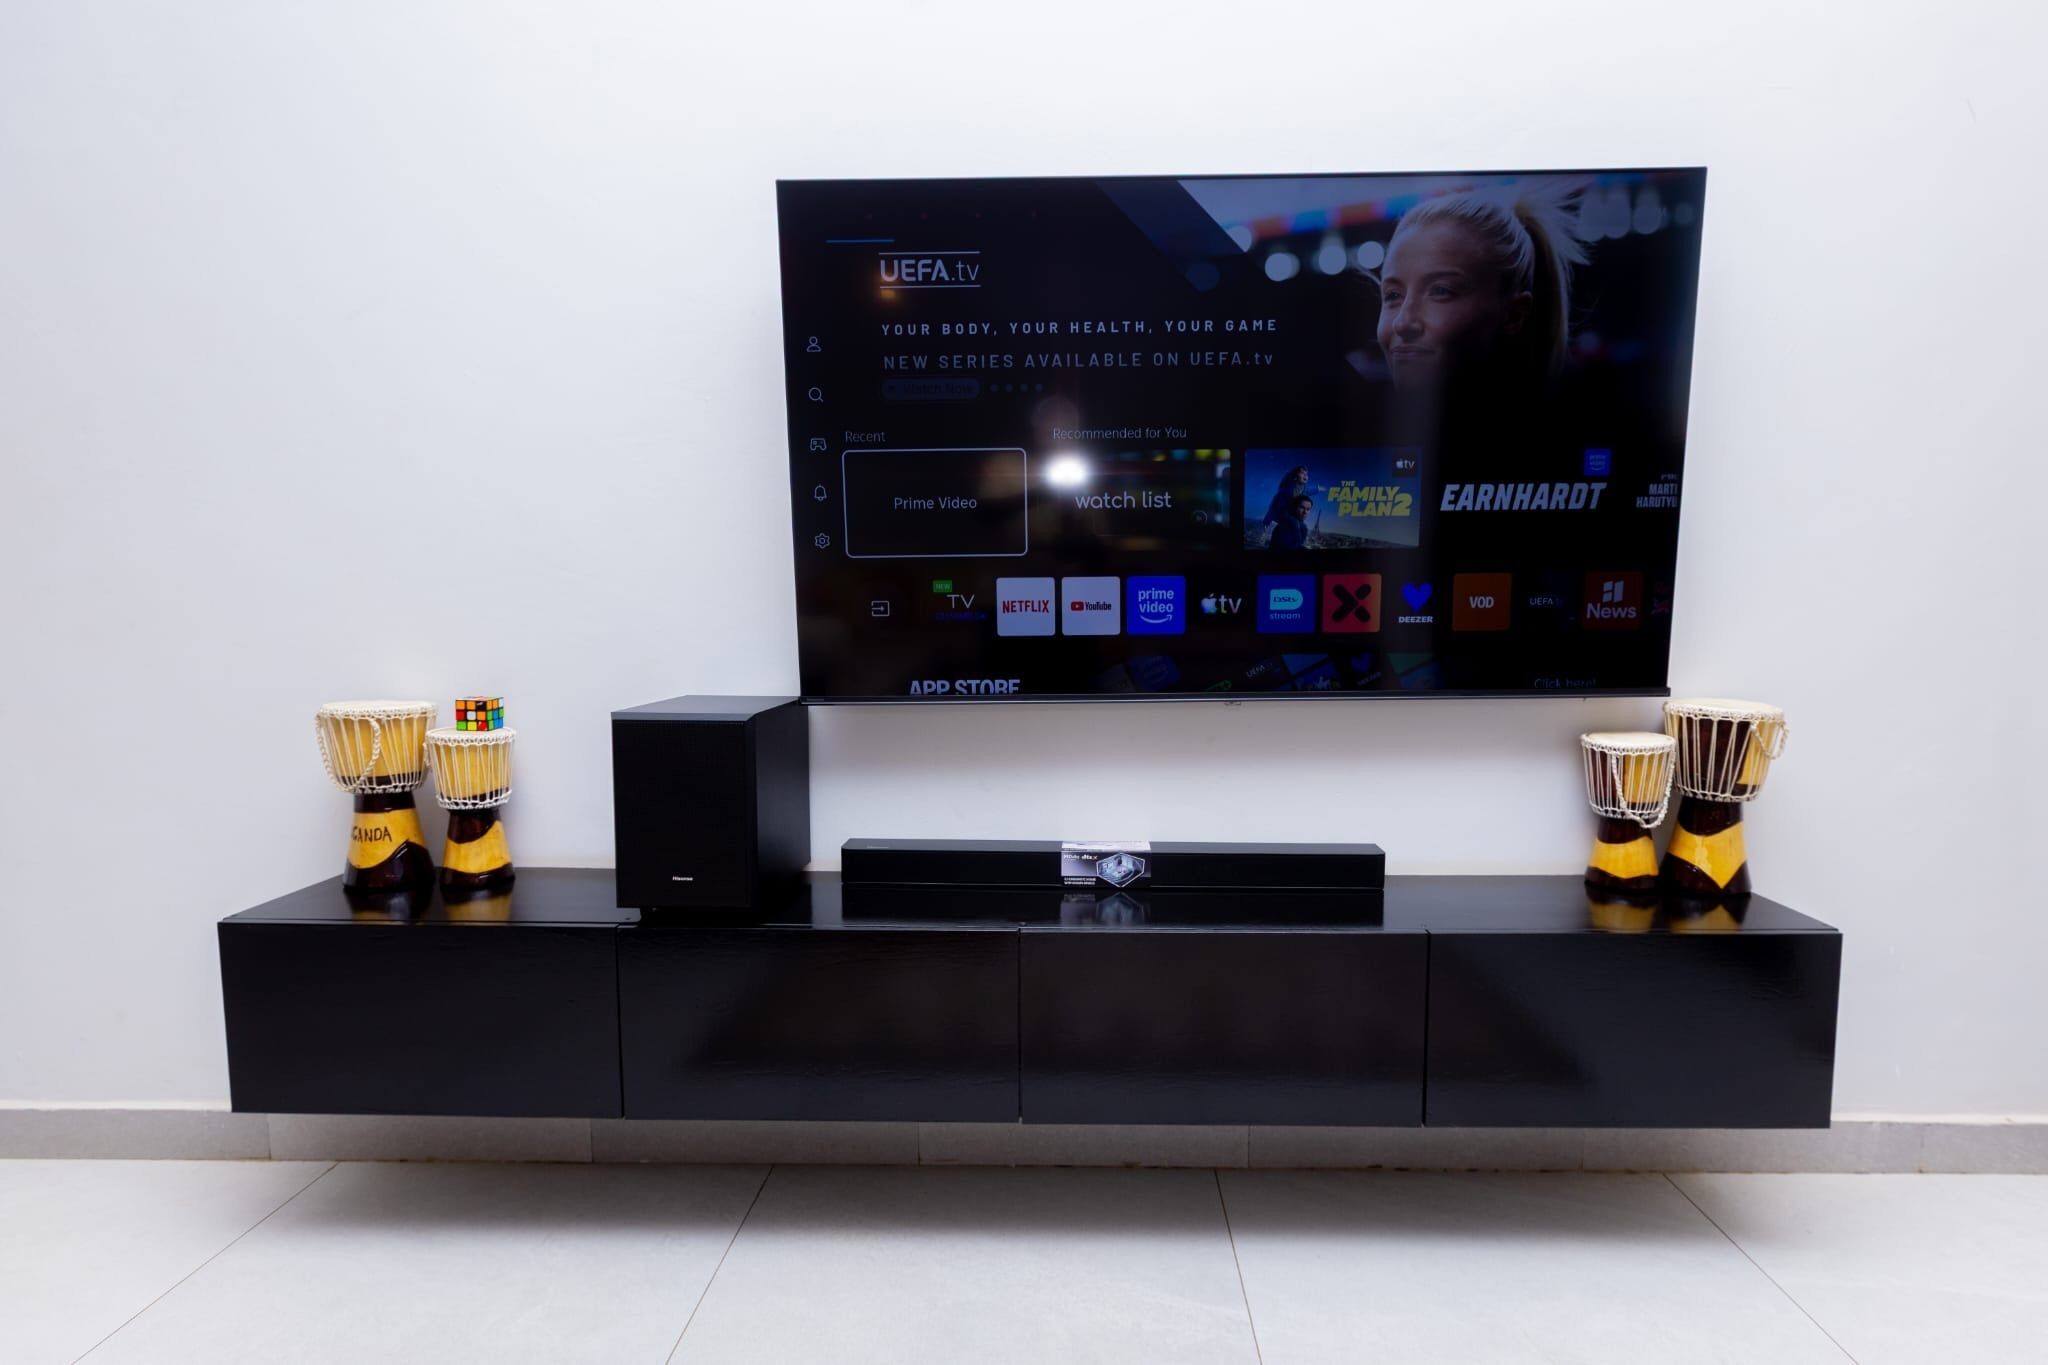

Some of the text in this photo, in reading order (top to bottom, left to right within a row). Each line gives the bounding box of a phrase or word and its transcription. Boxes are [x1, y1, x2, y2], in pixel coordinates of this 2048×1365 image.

[880, 258, 979, 282] UEFA.tv
[881, 318, 1278, 337] YOUR BODY, YOUR HEALTH, YOUR GAME
[883, 350, 1274, 369] NEW SERIES AVAILABLE ON UEFA.tv
[845, 430, 887, 443] Recent
[1052, 426, 1188, 440] Recommended for You
[1404, 459, 1415, 469] tv
[1075, 490, 1172, 510] watch list
[1327, 486, 1400, 502] FAMILY
[1440, 482, 1607, 511] EARNHARDT
[893, 496, 978, 510] Prime Video
[946, 594, 976, 609] TV
[1138, 588, 1175, 601] prime
[1529, 597, 1554, 606] UEFA
[1002, 599, 1050, 614] NETFLIX
[1085, 601, 1112, 612] YouTube
[1138, 601, 1174, 613] video
[1218, 594, 1242, 614] tv
[1469, 595, 1495, 609] VOD
[1269, 611, 1303, 621] stream
[1586, 602, 1638, 619] News
[1397, 615, 1433, 624] DEEZER
[910, 679, 950, 695] APP
